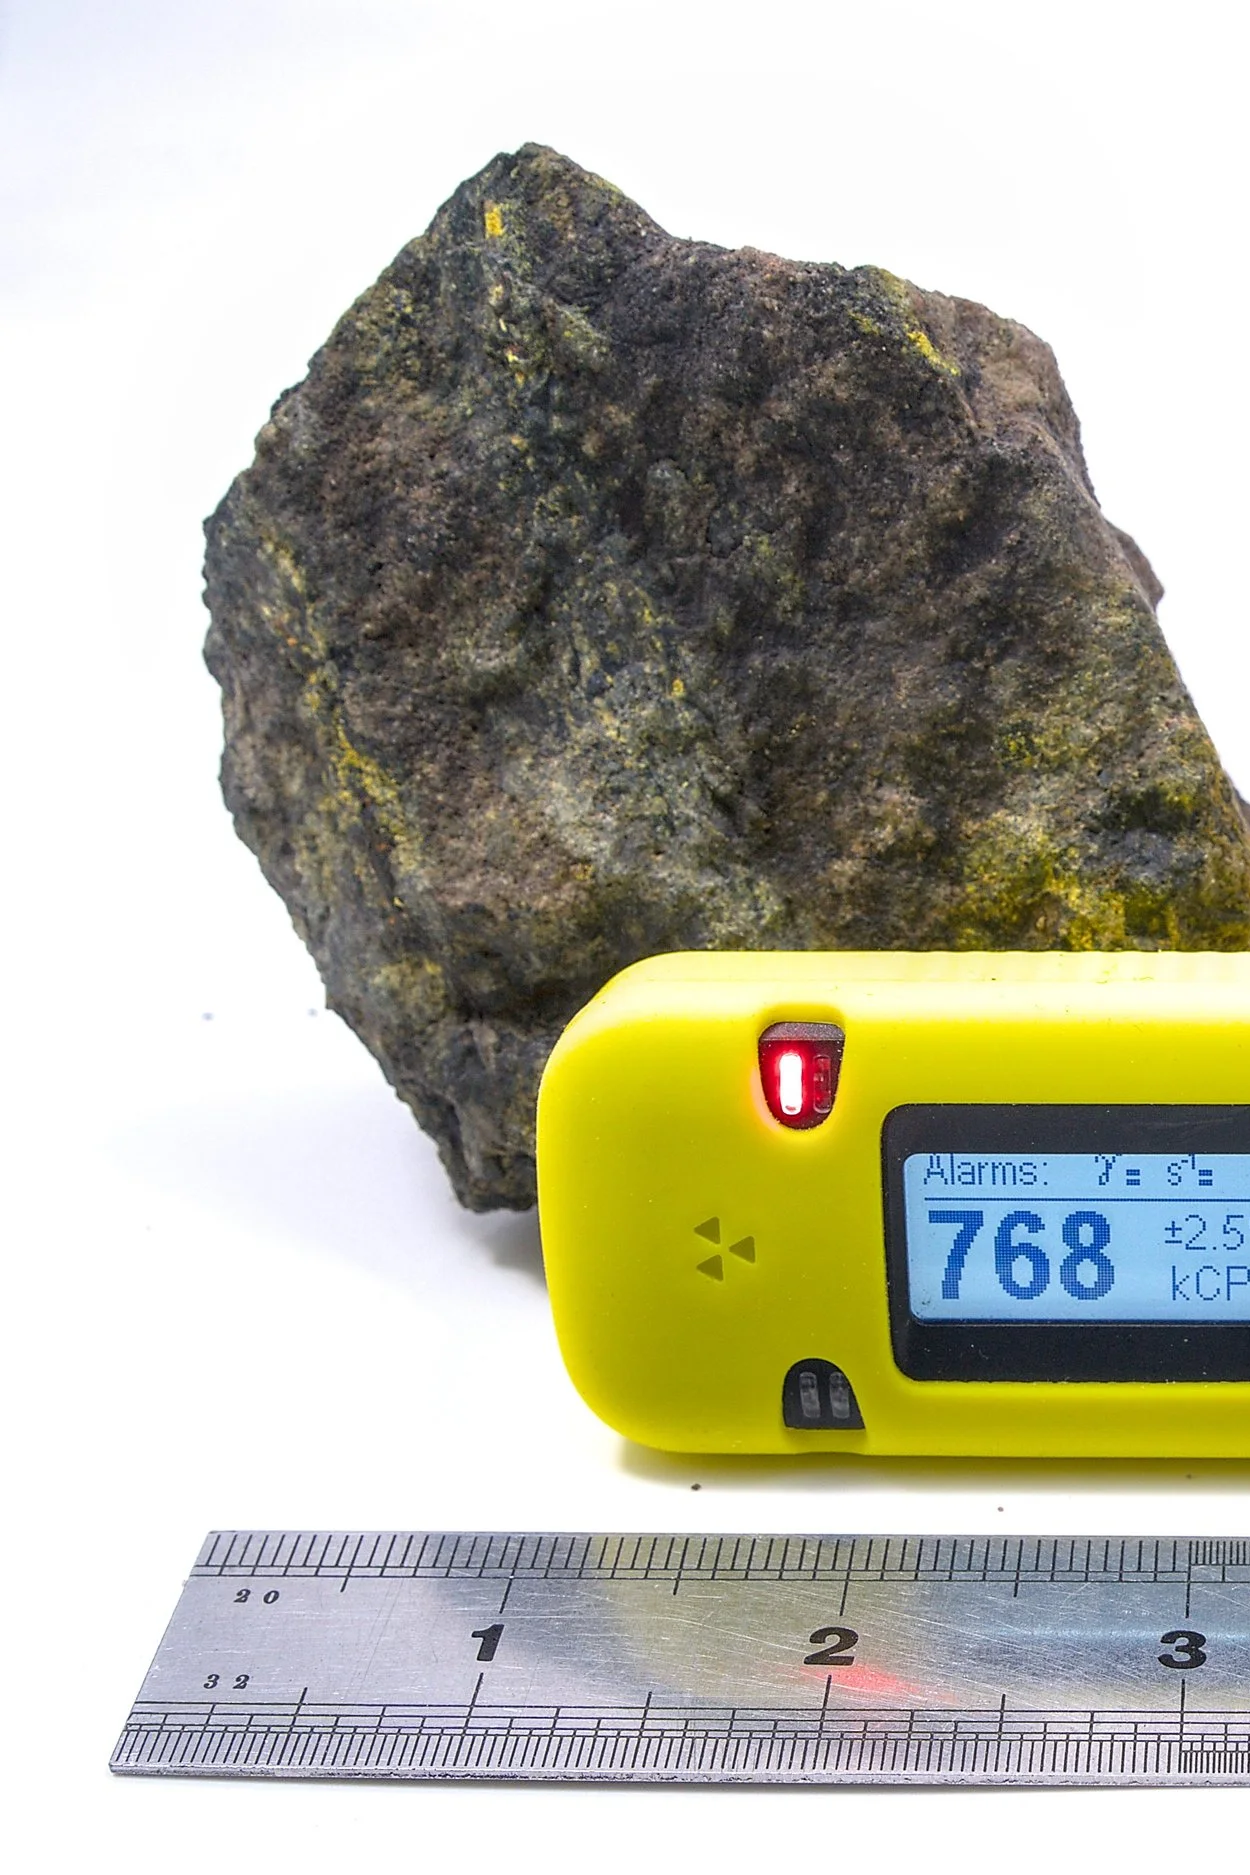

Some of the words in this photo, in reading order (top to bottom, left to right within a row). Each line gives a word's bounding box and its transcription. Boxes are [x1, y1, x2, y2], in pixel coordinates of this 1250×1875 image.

[923, 1154, 1048, 1186] Alarms:
[927, 1209, 1116, 1301] 768
[470, 1623, 506, 1663] 1
[803, 1626, 860, 1667] 2
[1157, 1630, 1208, 1670] 3
